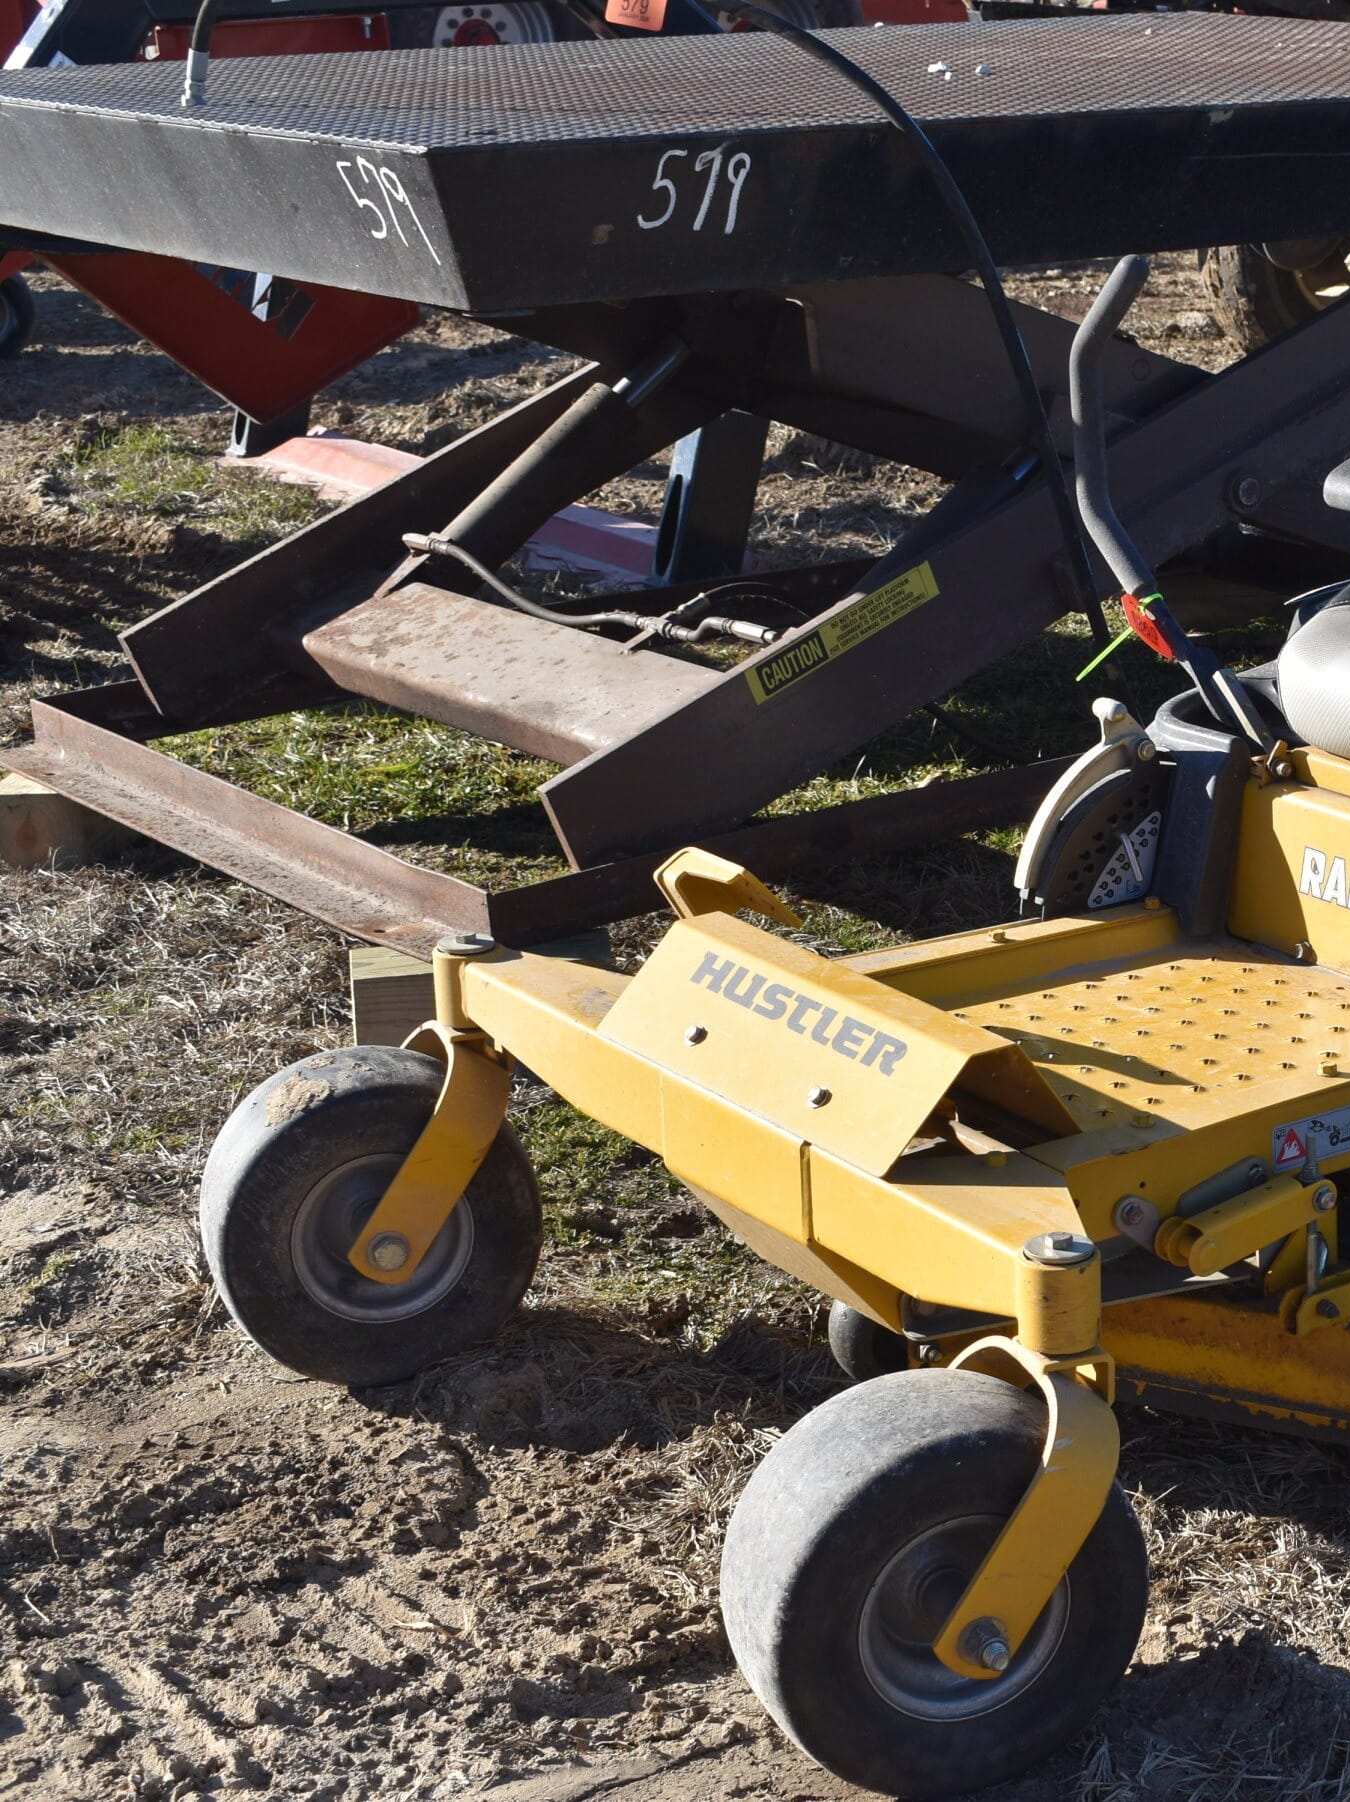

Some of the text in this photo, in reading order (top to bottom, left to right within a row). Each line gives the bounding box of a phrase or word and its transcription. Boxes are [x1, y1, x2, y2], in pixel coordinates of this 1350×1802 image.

[336, 155, 441, 266] 579
[884, 577, 909, 596] PLATFORM
[762, 638, 824, 689] CAUTION
[690, 951, 908, 1077] HUSTLER
